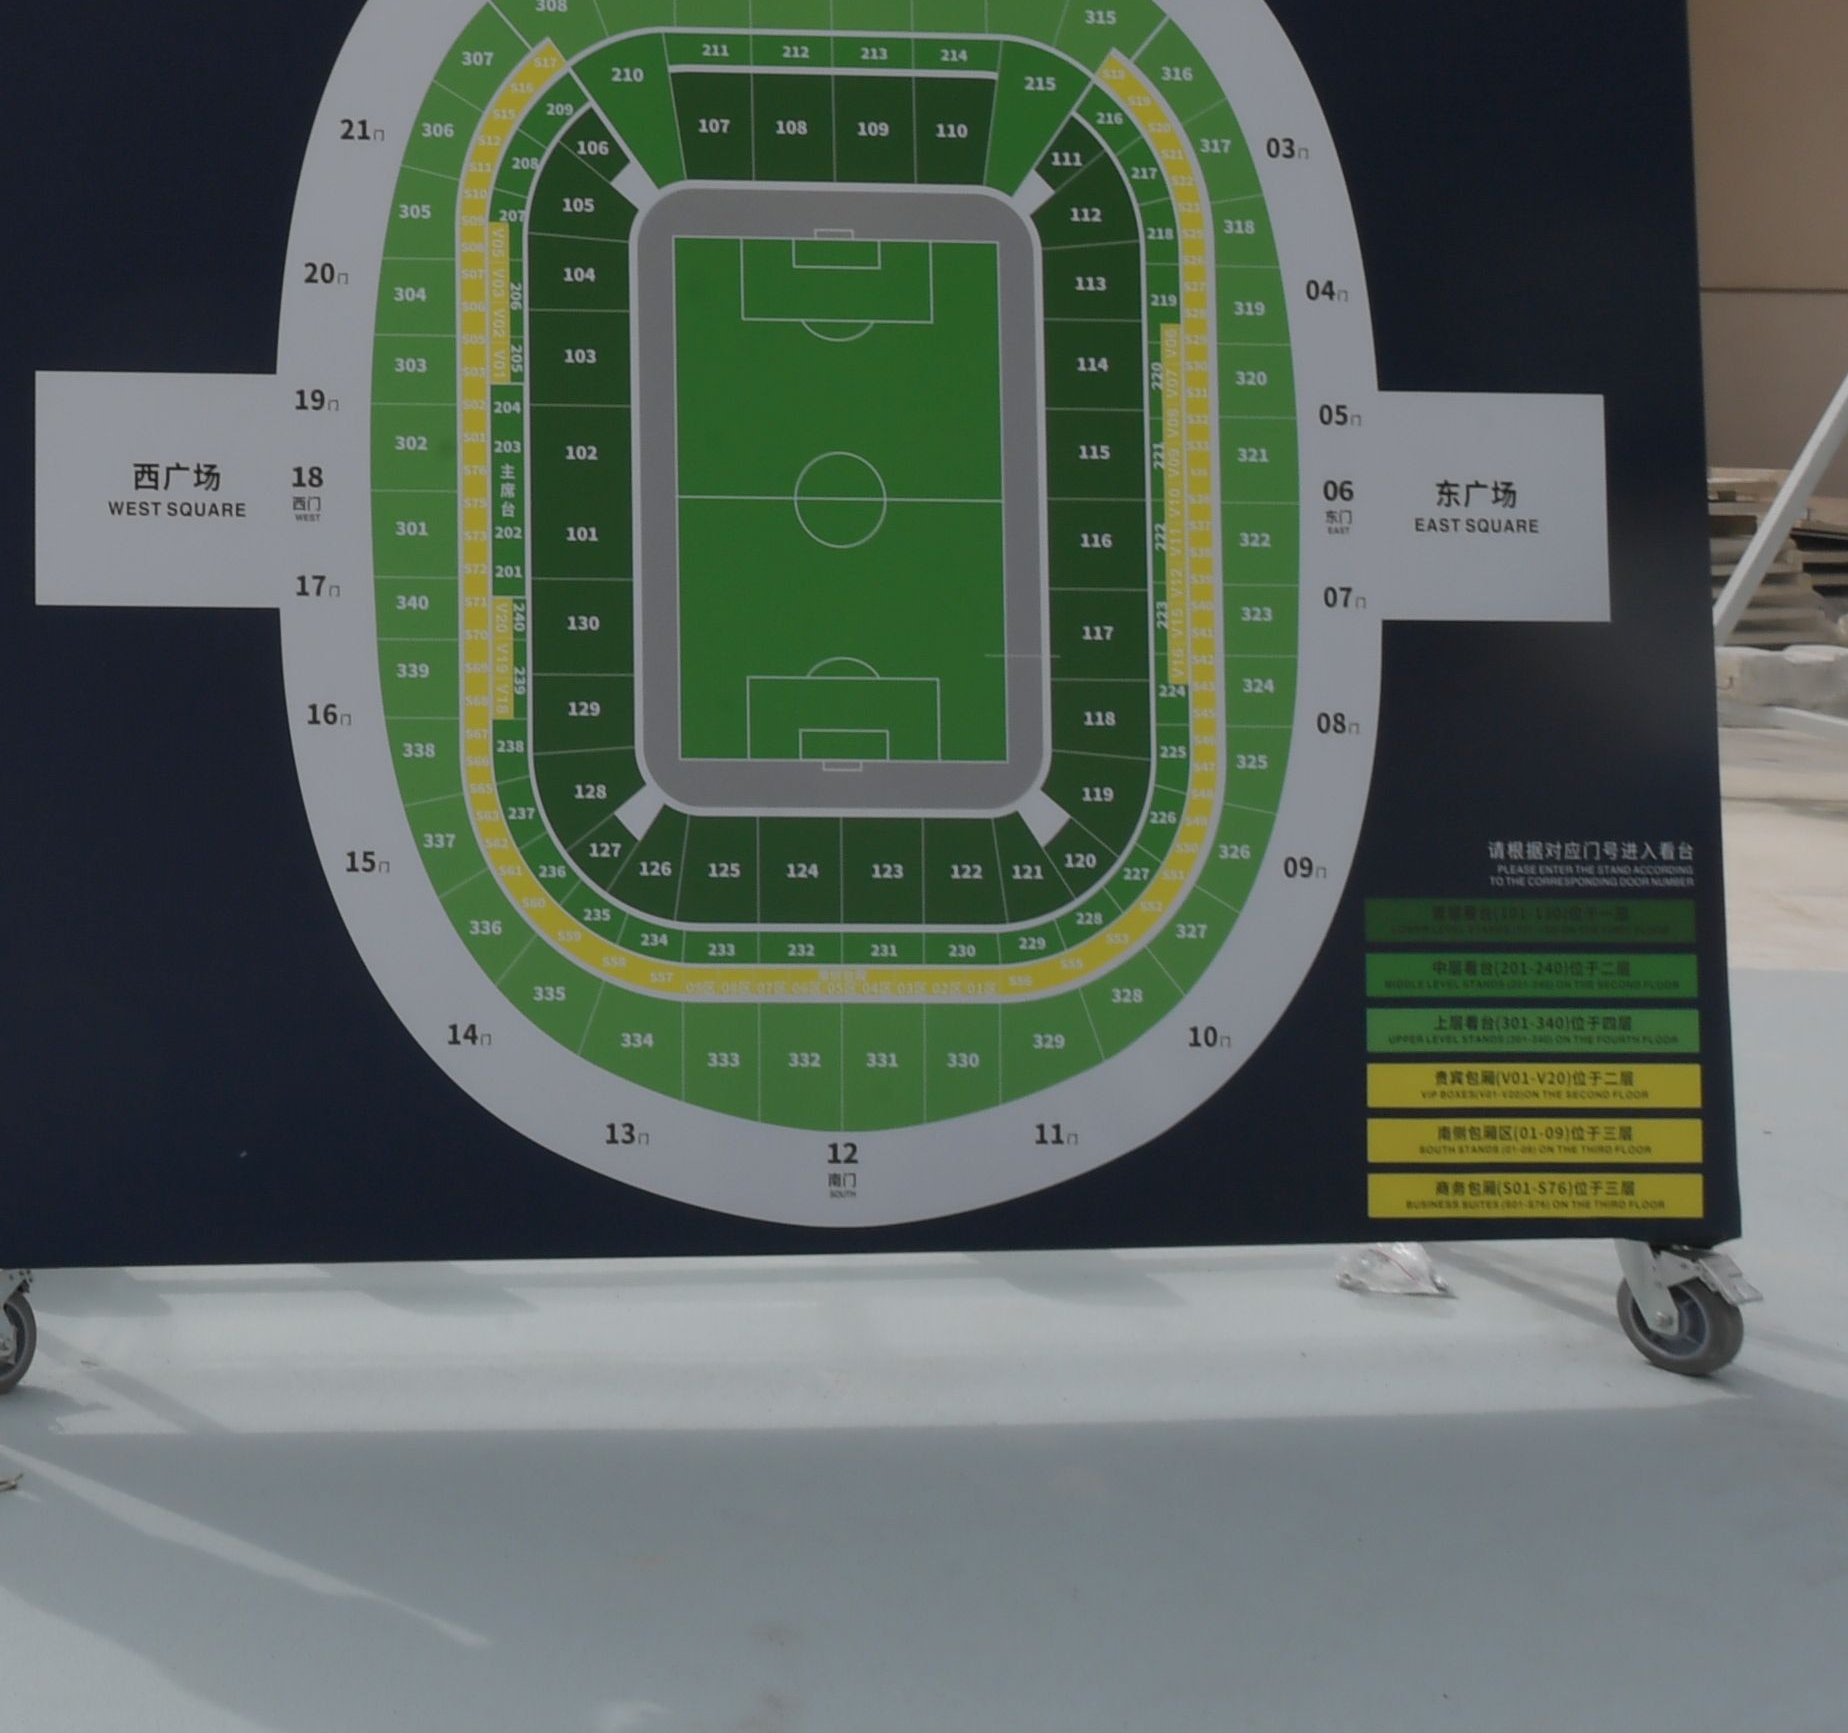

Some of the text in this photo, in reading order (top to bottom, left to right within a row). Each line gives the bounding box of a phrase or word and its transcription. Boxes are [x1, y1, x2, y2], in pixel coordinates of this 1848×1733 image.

[1085, 9, 1117, 25] 315
[462, 51, 494, 66] 307
[782, 45, 810, 59] 212
[611, 67, 645, 83] 210
[1161, 65, 1194, 82] 316
[1024, 76, 1057, 92] 215
[546, 103, 575, 117] 209
[698, 118, 731, 134] 107
[857, 121, 890, 137] 109
[936, 123, 969, 139] 110
[577, 140, 609, 156] 106
[1051, 151, 1083, 167] 111
[399, 203, 432, 220] 305
[562, 197, 595, 213] 105
[1223, 219, 1256, 235] 318
[1075, 276, 1107, 292] 113
[510, 281, 523, 311] 206
[1150, 293, 1178, 307] 219
[564, 348, 597, 364] 103
[394, 357, 428, 373] 303
[1235, 370, 1268, 386] 320
[494, 440, 522, 454] 203
[1079, 444, 1111, 460] 115
[132, 461, 222, 493] 西广场
[291, 465, 325, 489] 18
[499, 463, 517, 519] 主席台
[1322, 479, 1355, 503] 06
[1434, 478, 1518, 510] 东广场
[107, 500, 247, 518] WEST SQUARE
[292, 495, 322, 512] 西门
[1324, 509, 1353, 525] 东门
[395, 520, 429, 537] 301
[566, 526, 599, 542] 101
[1414, 517, 1540, 535] EAST SQUARE
[1239, 531, 1271, 548] 322
[495, 565, 523, 579] 201
[1082, 625, 1114, 641] 117
[396, 662, 430, 679] 339
[1242, 677, 1275, 694] 324
[568, 701, 601, 717] 129
[1082, 786, 1114, 802] 119
[423, 833, 457, 849] 337
[589, 842, 622, 858] 127
[1218, 844, 1251, 860] 326
[1488, 841, 1693, 860] 请根据对应门号进入看台
[708, 862, 741, 878] 125
[871, 863, 904, 879] 123
[1497, 864, 1693, 875] PLEASE ENTER THE STAND ACCORDING
[1489, 876, 1504, 887] TO
[1506, 876, 1525, 887] THE
[1620, 876, 1649, 887] DOOR
[583, 908, 612, 922] 235
[1076, 912, 1104, 925] 228
[787, 943, 816, 957] 232
[533, 985, 567, 1002] 335
[1111, 987, 1144, 1004] 328
[707, 1051, 741, 1068] 333
[866, 1052, 899, 1068] 331
[826, 1141, 860, 1165] 12
[827, 1171, 857, 1188] 南门
